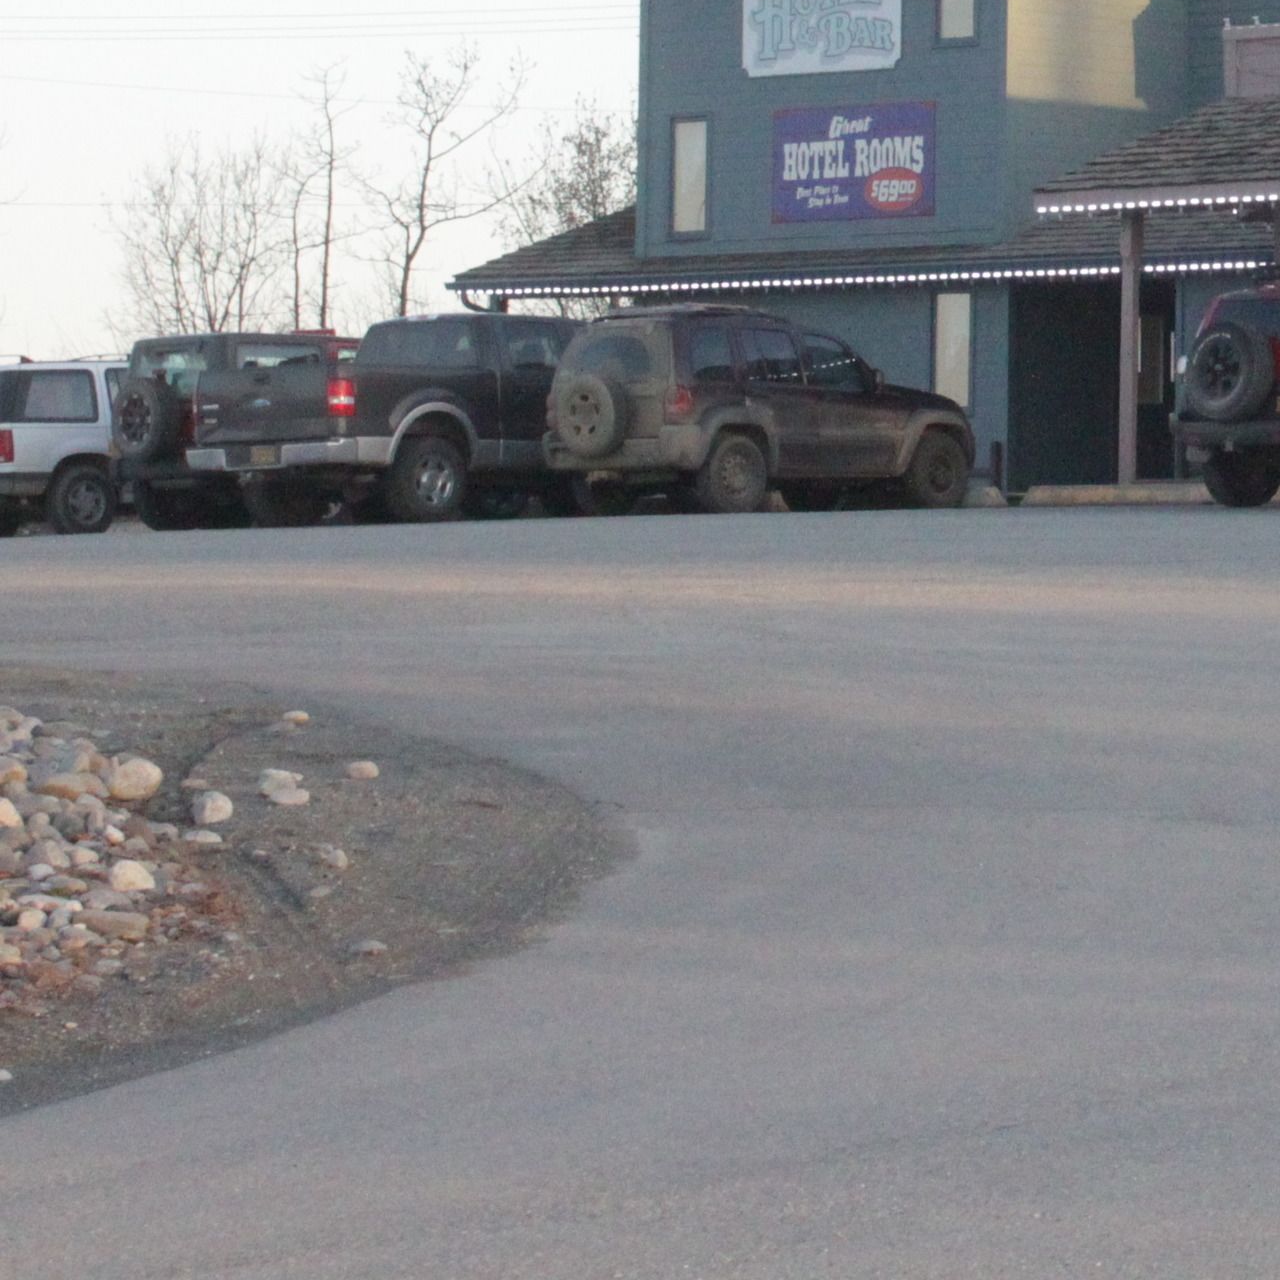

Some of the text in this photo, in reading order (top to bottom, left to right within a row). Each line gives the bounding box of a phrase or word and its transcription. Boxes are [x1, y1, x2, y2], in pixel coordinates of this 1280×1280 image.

[796, 11, 895, 58] & BAR
[829, 116, 873, 138] Great
[783, 135, 924, 181] HOTEL ROOMS
